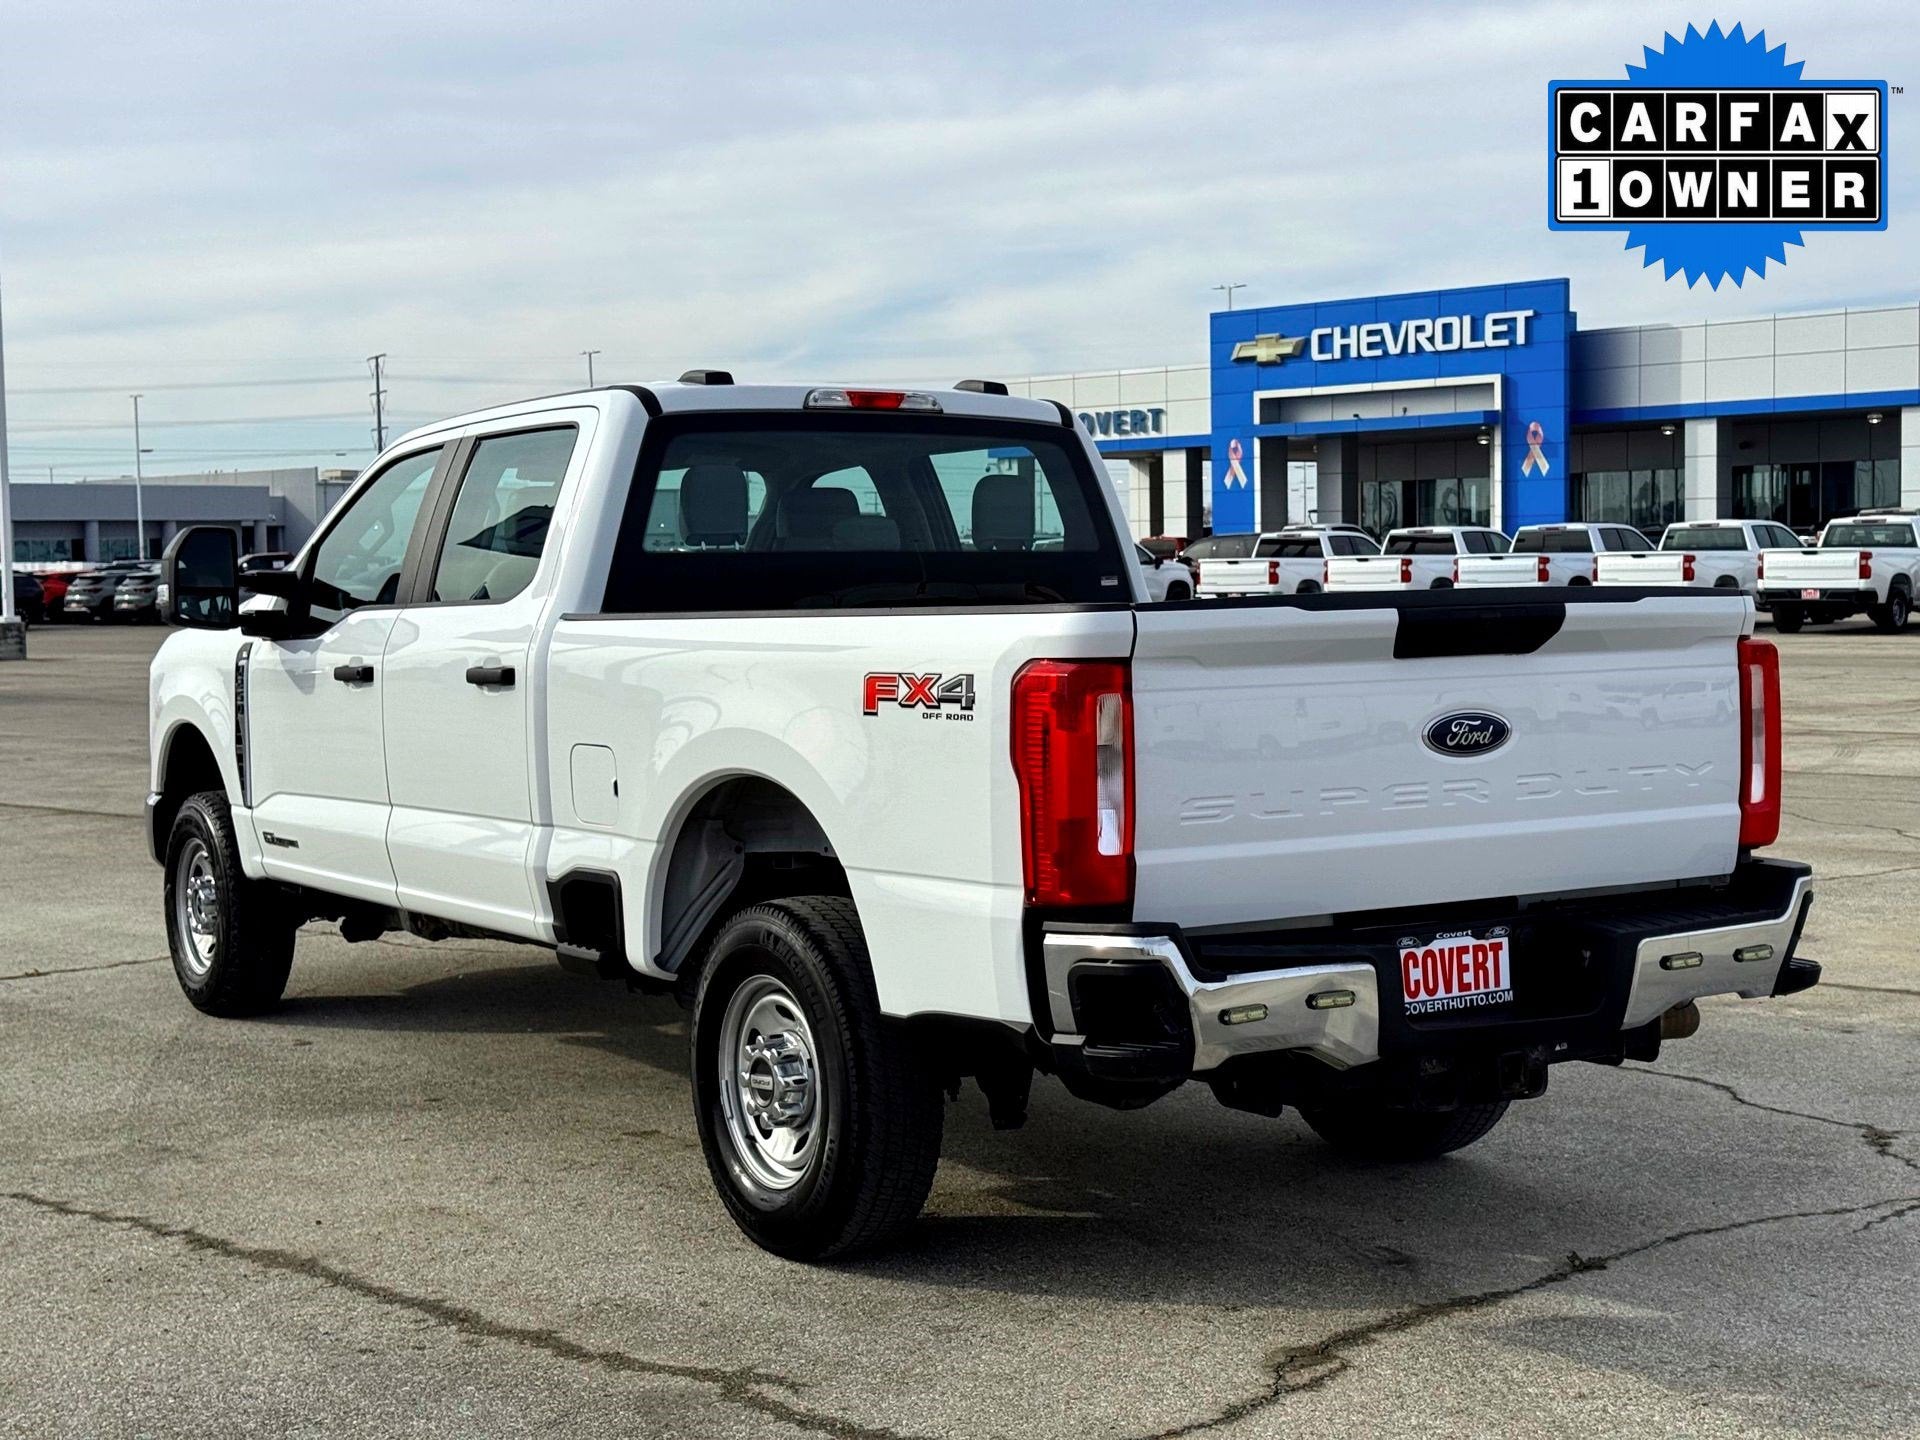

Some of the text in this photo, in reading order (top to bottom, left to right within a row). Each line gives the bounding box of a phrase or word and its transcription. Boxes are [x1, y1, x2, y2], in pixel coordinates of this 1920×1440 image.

[1310, 309, 1534, 361] CHEVROLET
[1078, 408, 1165, 436] OVERT
[863, 671, 976, 717] FX4
[922, 712, 974, 721] OFF ROAD
[1446, 719, 1494, 747] Ford
[1180, 761, 1714, 826] SUPER DUTY
[1436, 929, 1472, 939] Covert
[1402, 941, 1504, 1000] COVERT
